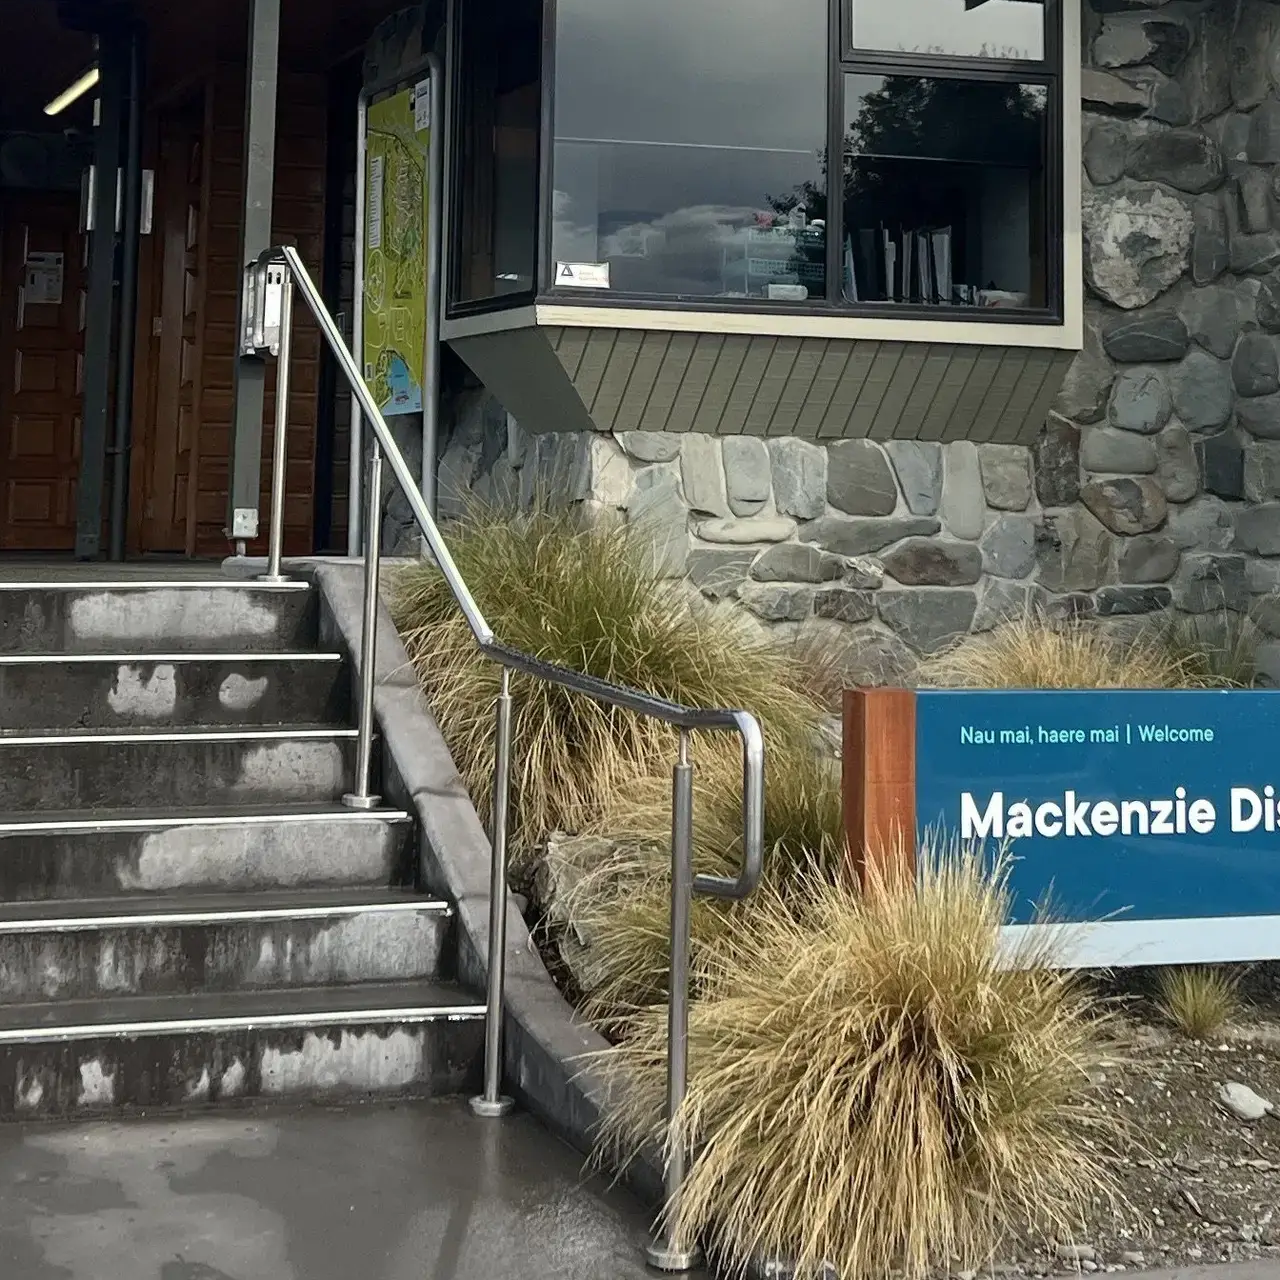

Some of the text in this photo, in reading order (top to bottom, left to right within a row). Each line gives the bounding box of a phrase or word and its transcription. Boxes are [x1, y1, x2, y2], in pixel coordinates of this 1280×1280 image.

[960, 726, 995, 744] Nau
[1000, 725, 1034, 745] mai,
[1038, 725, 1085, 743] haere
[1090, 725, 1119, 743] mai
[1137, 724, 1214, 742] Welcome
[961, 786, 1216, 838] Mackenzie
